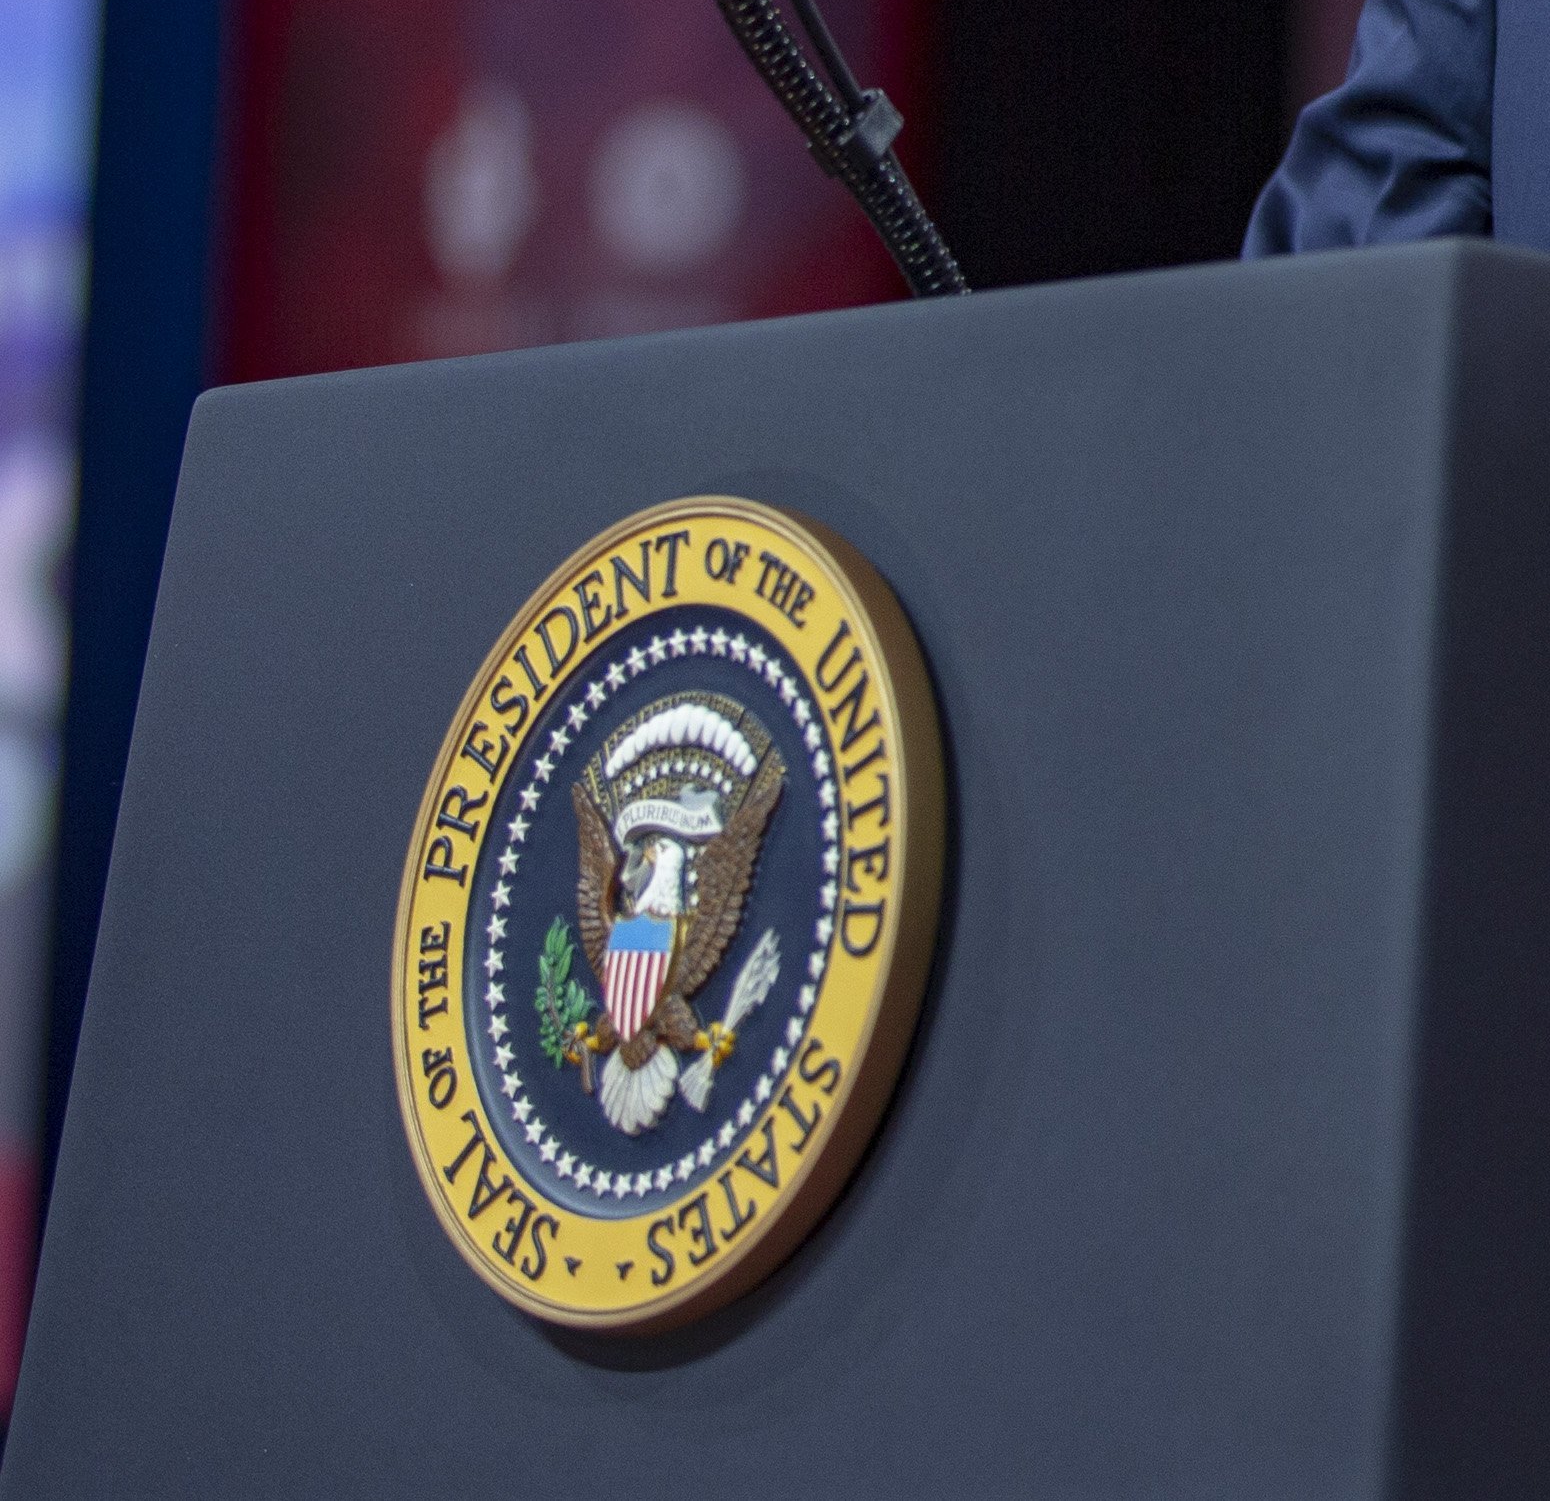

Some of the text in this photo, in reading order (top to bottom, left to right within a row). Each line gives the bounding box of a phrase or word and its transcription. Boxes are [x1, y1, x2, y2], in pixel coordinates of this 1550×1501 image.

[418, 529, 891, 1287] SEAL OF THE PRESIDENT OF THE UNITED STATES
